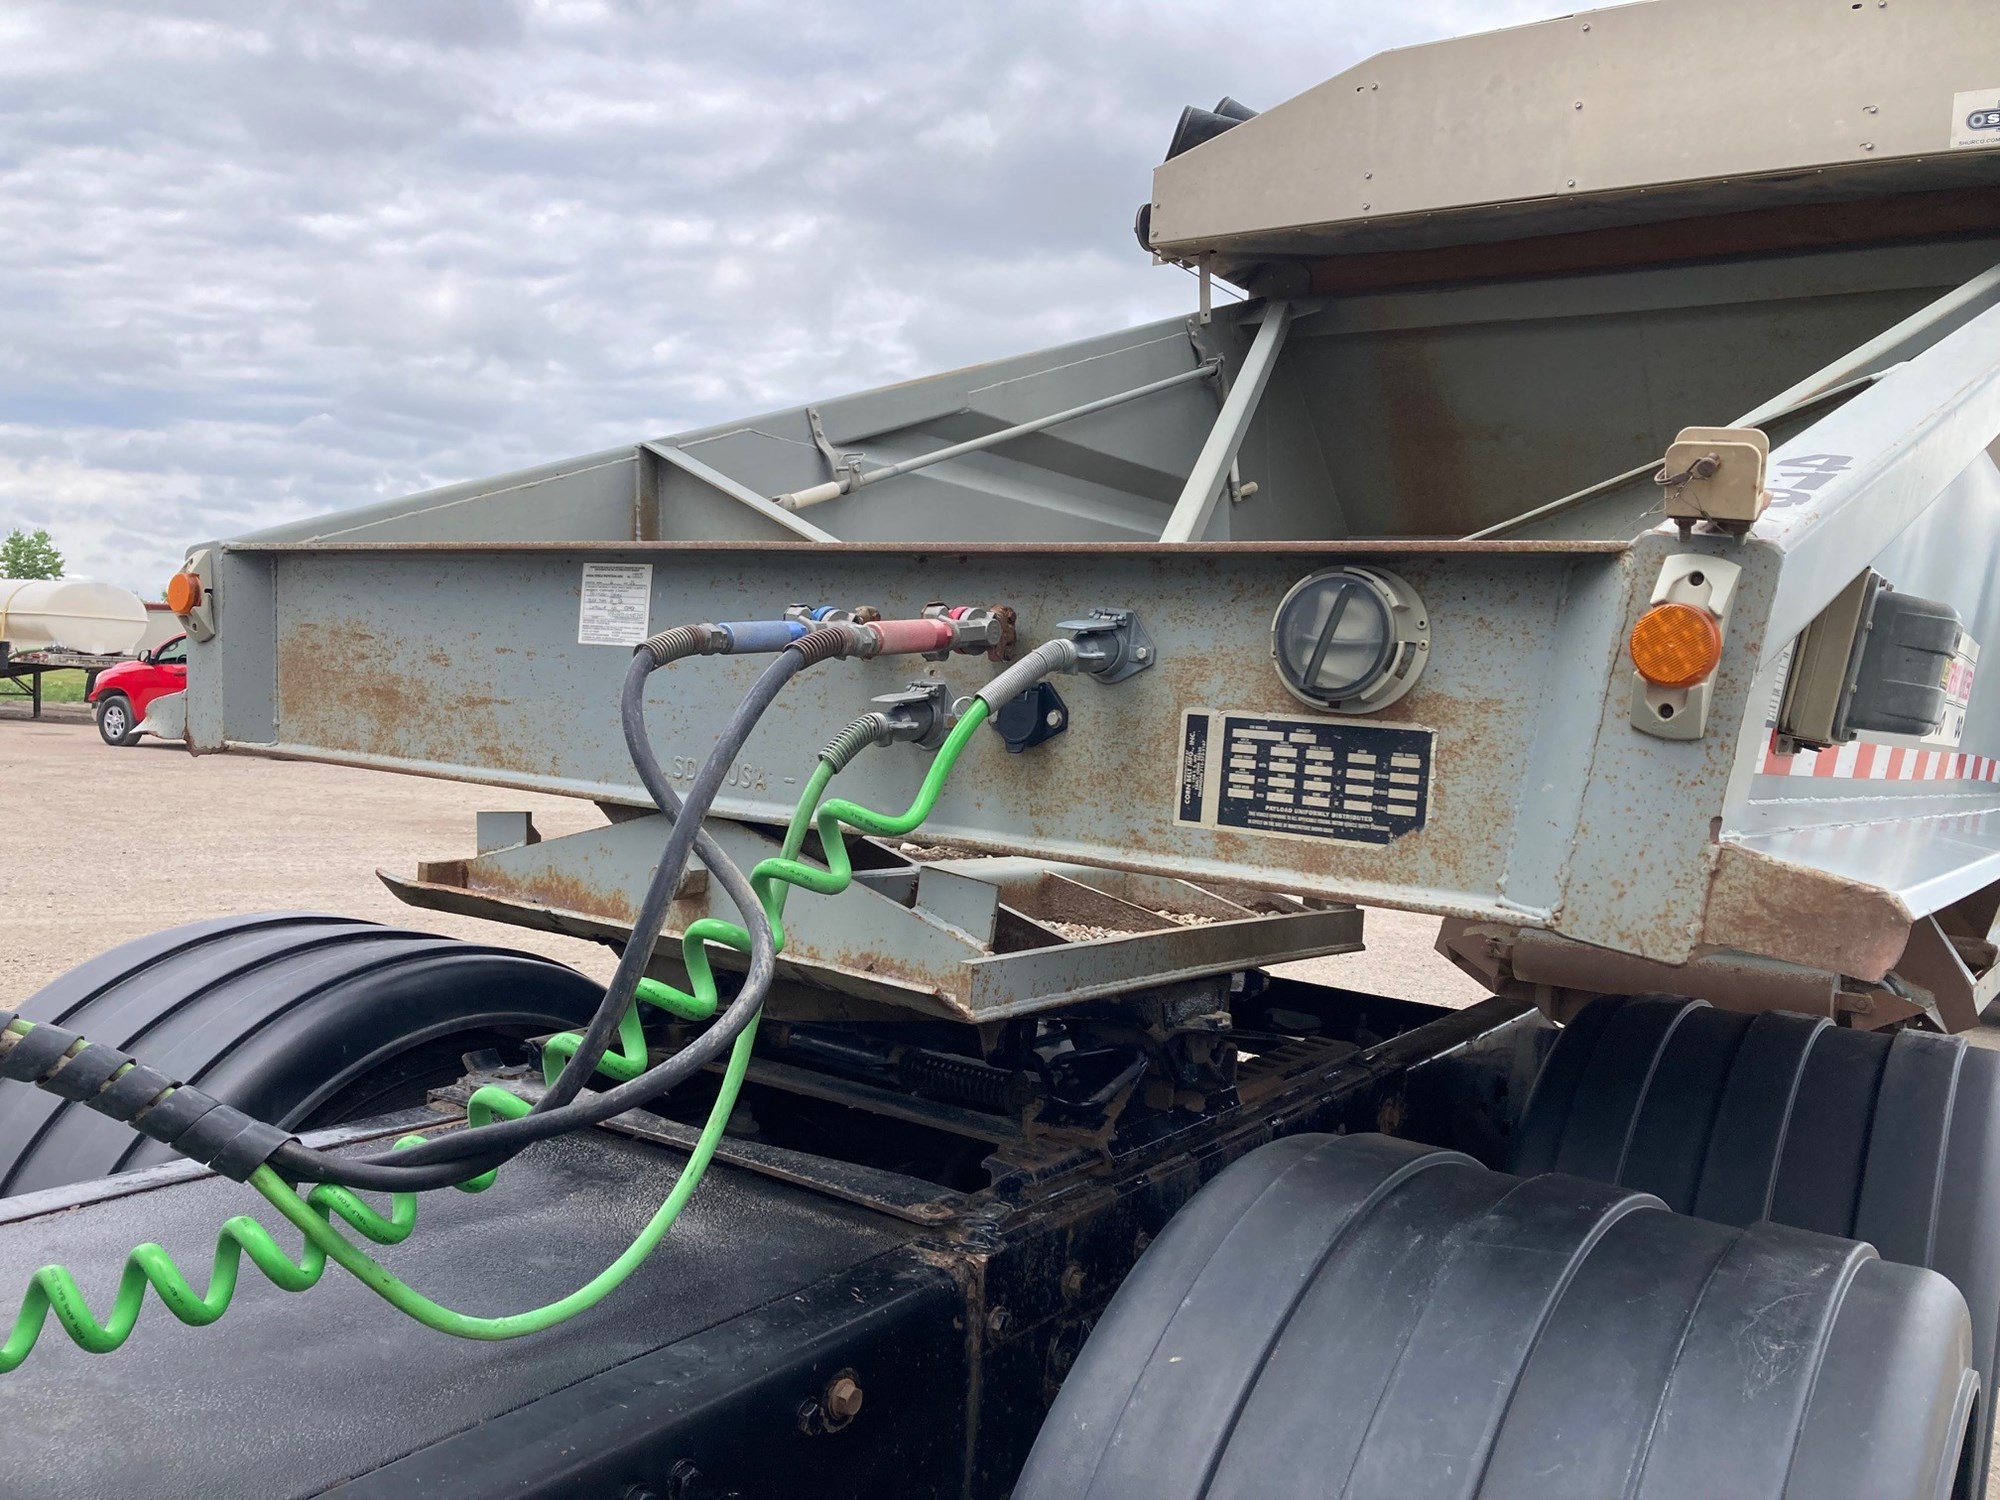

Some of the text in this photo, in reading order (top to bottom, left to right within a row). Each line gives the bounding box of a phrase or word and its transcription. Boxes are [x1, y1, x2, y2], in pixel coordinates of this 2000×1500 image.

[1265, 805, 1293, 814] PAYLOAD
[1294, 808, 1330, 818] UNIFORMLY
[1331, 812, 1374, 823] DISTRIBUTED
